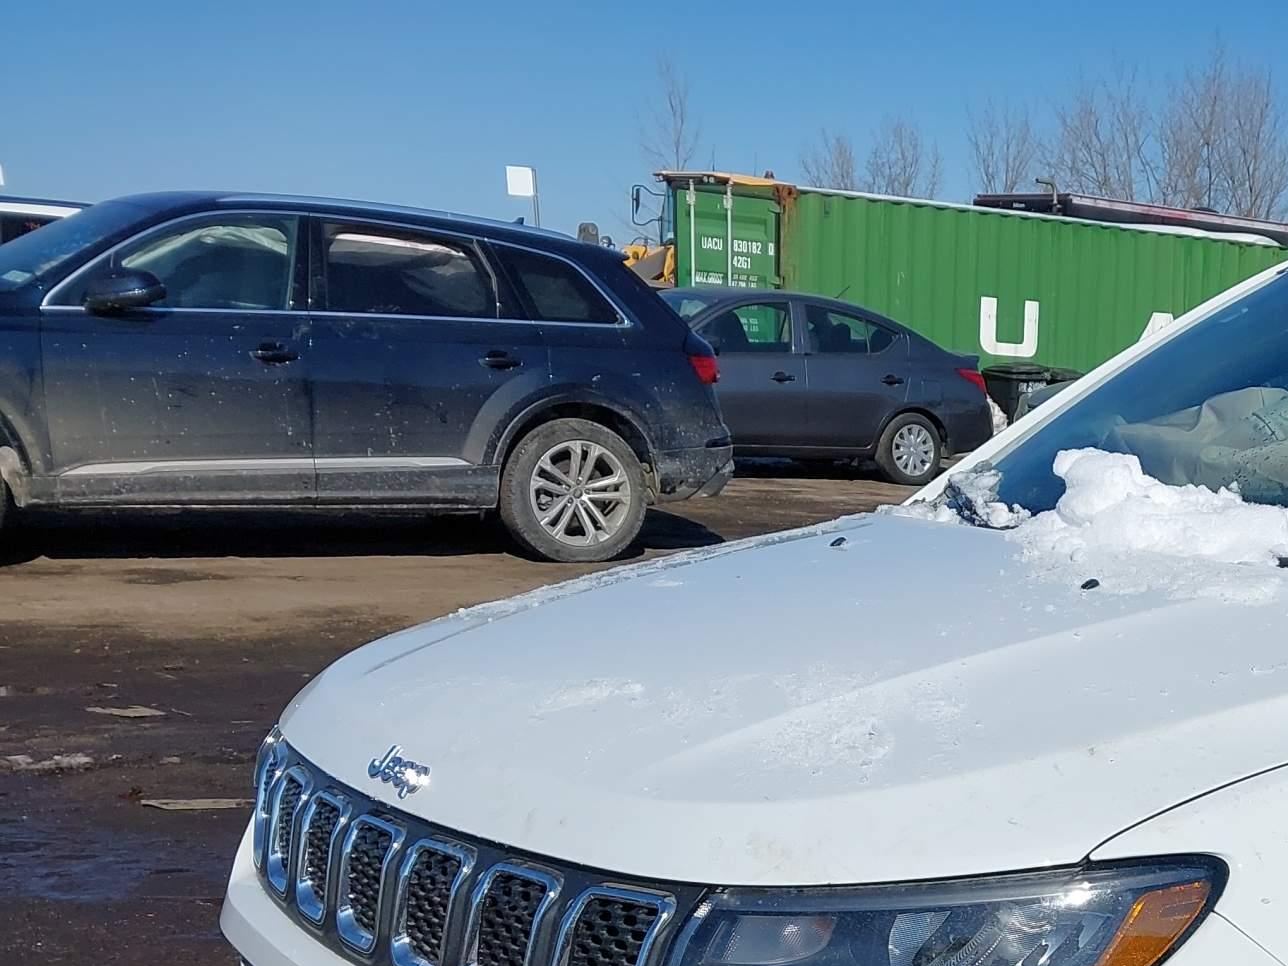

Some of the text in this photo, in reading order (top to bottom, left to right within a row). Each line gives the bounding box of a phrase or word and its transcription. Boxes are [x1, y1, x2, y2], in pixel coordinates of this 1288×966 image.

[701, 236, 723, 250] UACU
[733, 240, 762, 254] 830182
[732, 256, 751, 269] 42G1
[980, 296, 1039, 357] U
[368, 744, 431, 799] Jeep
